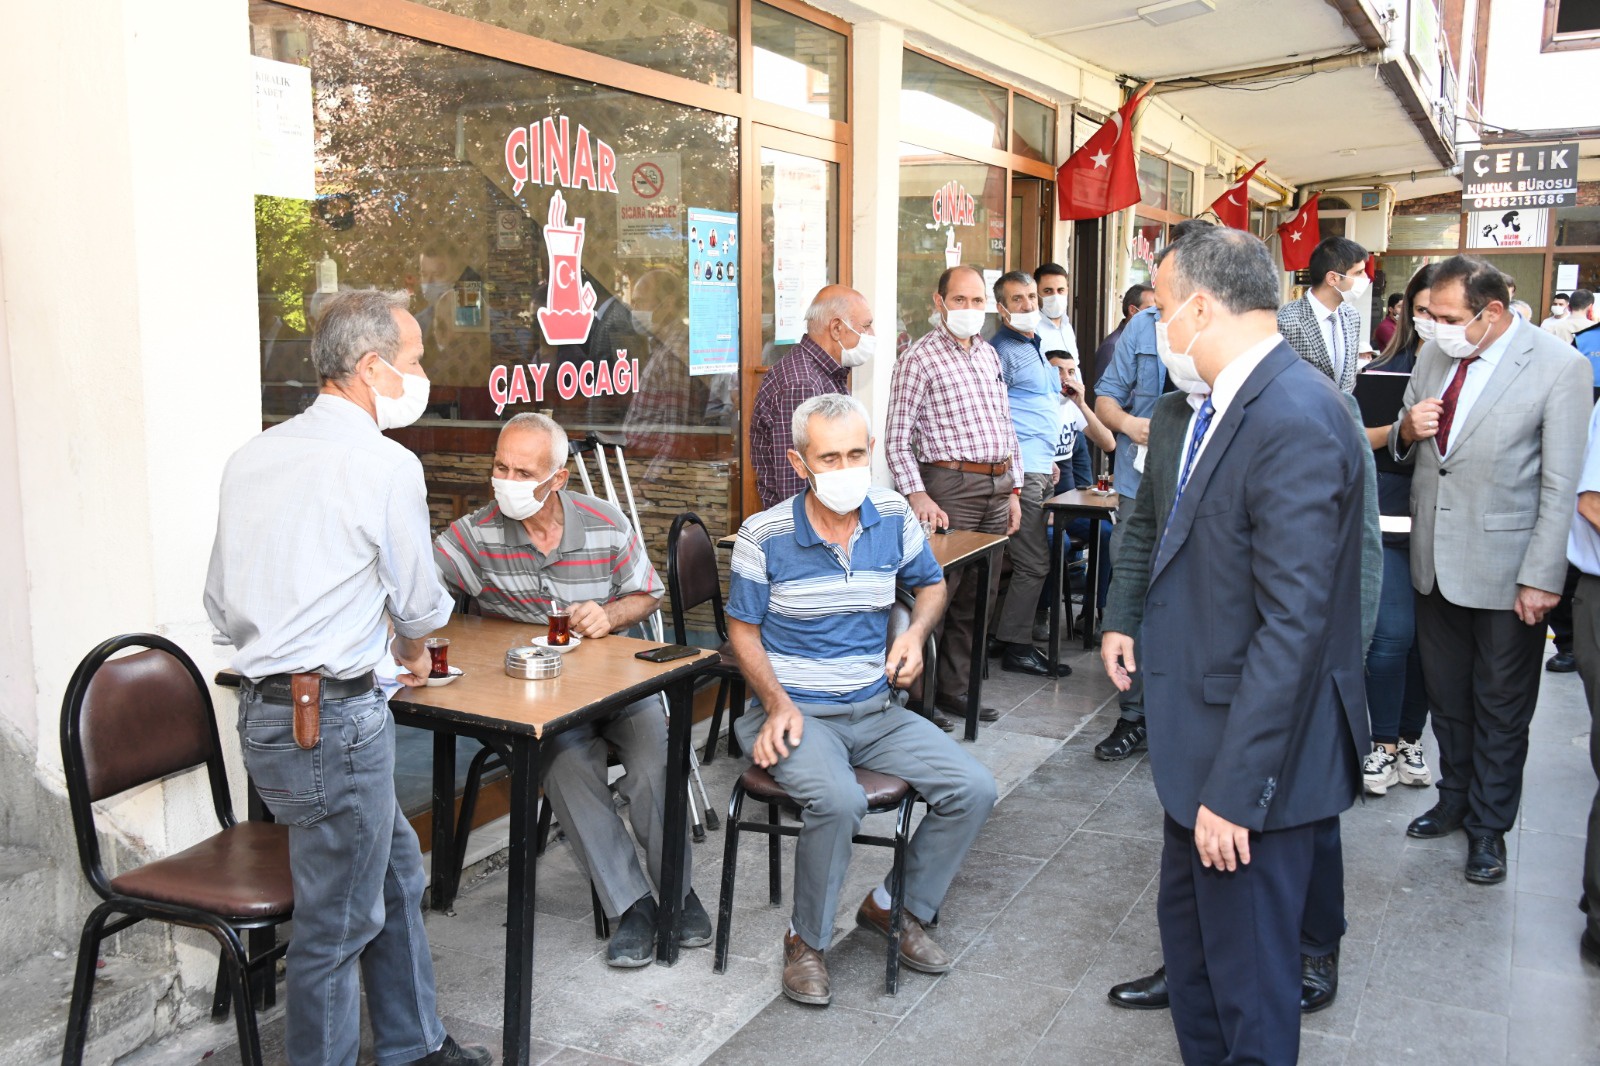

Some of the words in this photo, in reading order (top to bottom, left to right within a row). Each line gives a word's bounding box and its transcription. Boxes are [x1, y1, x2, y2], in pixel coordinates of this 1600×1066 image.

[505, 115, 619, 194] ÇINAR
[932, 180, 976, 231] ÇINAR
[1467, 182, 1513, 194] HUKUK
[1518, 178, 1573, 191] BÜROSU
[1474, 194, 1564, 208] 04562131686
[489, 362, 550, 415] ÇAY
[556, 349, 640, 400] OCAĞI
